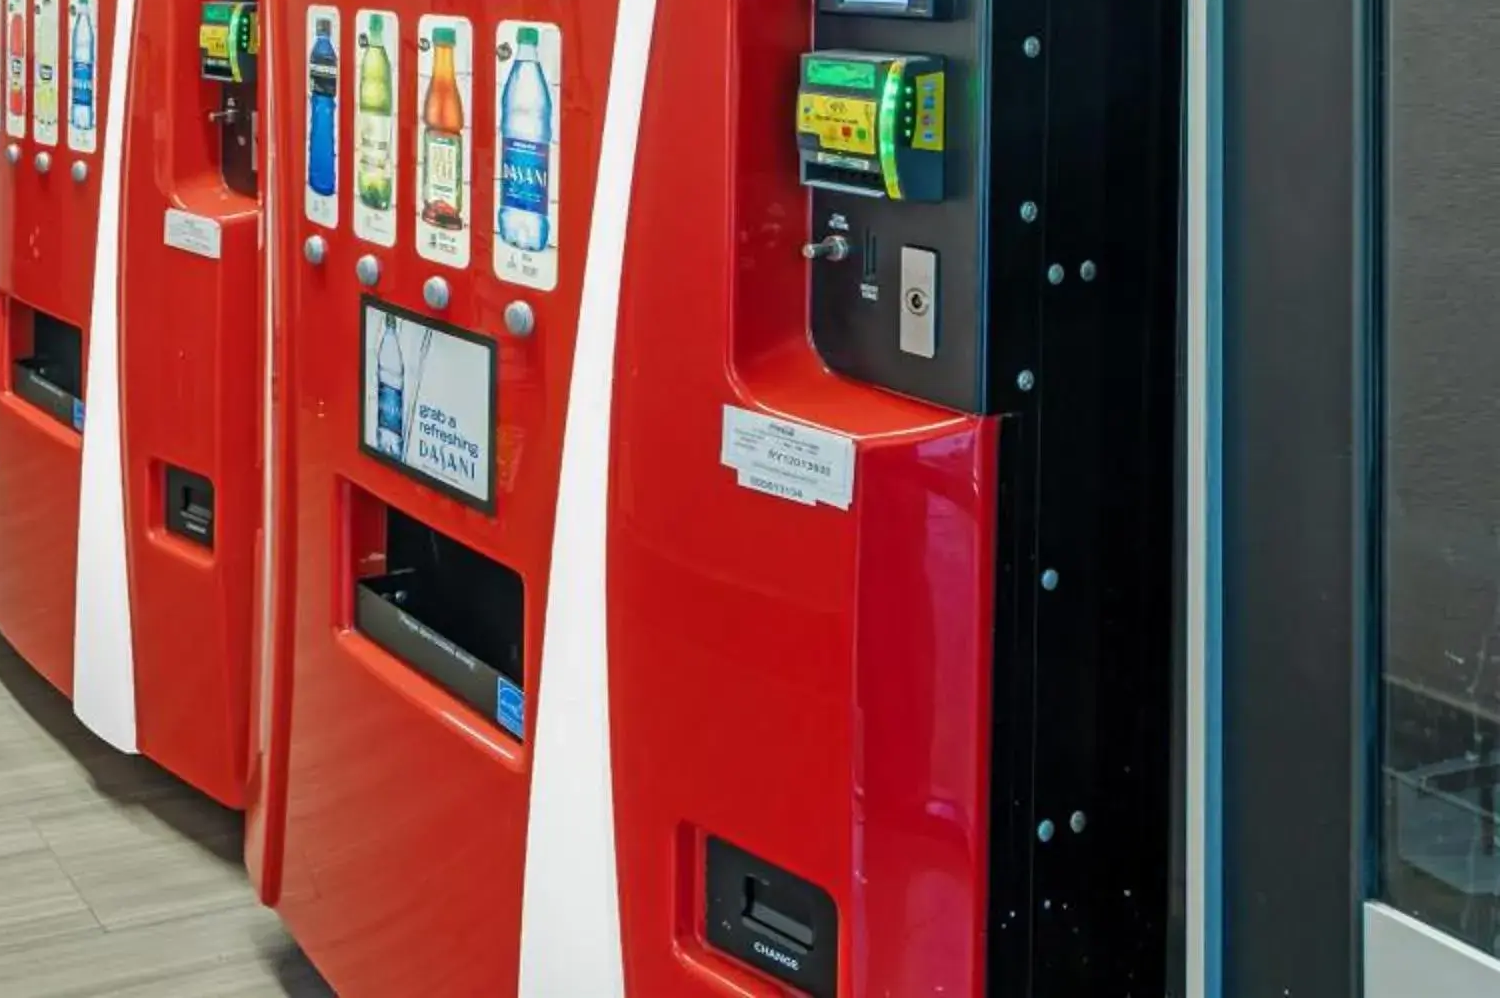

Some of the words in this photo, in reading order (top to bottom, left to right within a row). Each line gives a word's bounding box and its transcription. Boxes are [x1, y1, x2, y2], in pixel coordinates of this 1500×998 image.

[419, 404, 446, 424] grab
[447, 415, 457, 429] a
[419, 421, 480, 459] refreshing
[419, 439, 476, 480] DASANI
[753, 941, 800, 971] CHANGE
